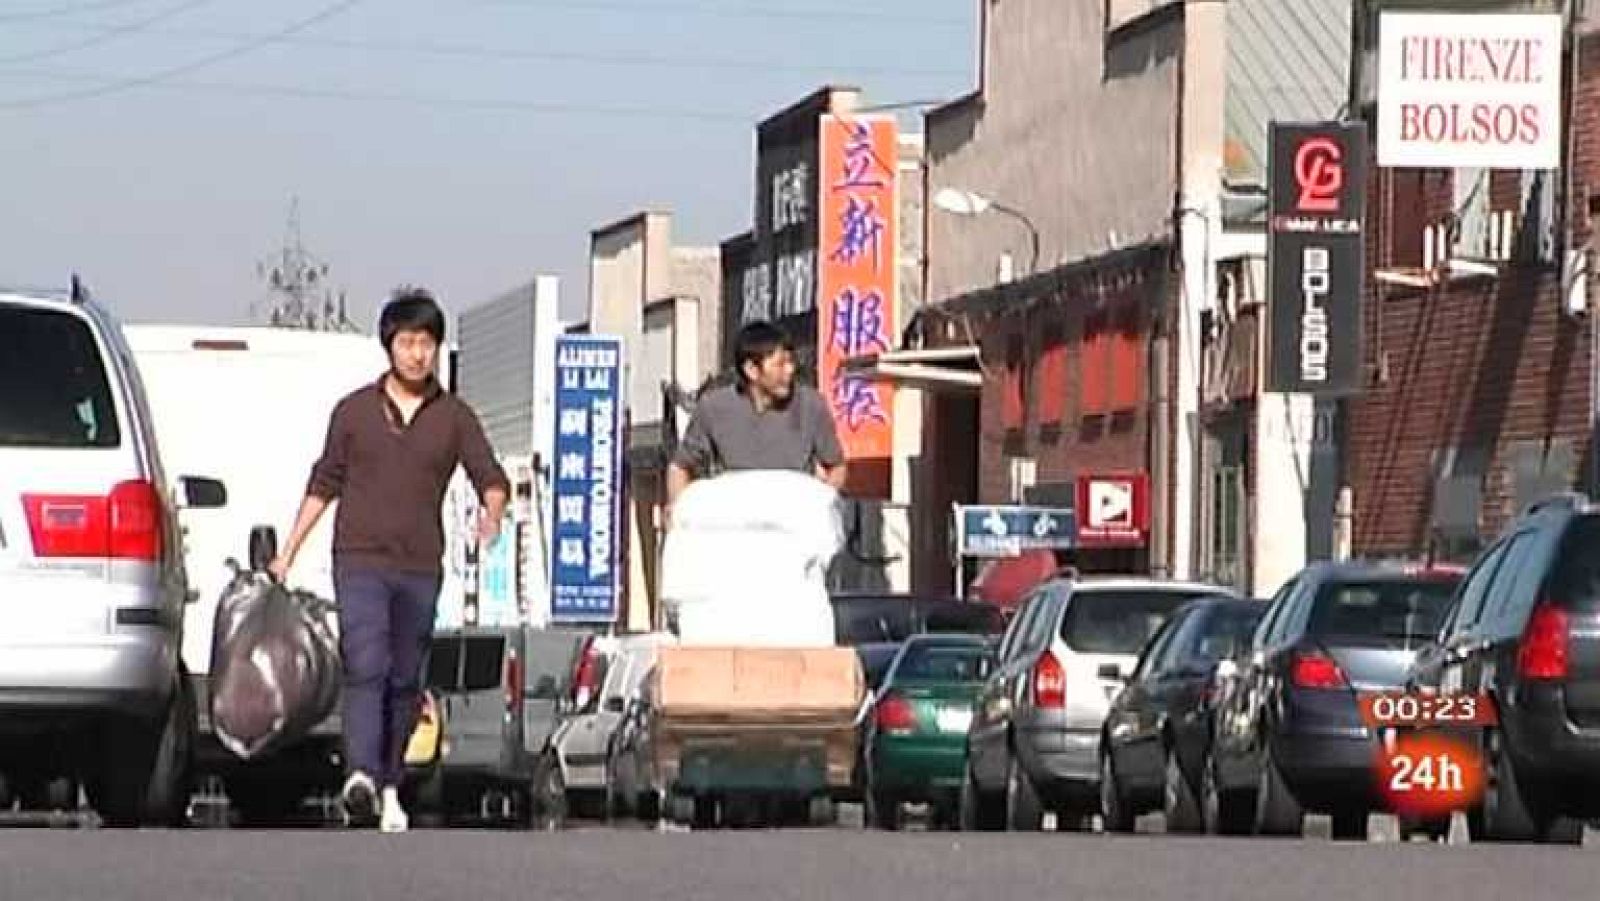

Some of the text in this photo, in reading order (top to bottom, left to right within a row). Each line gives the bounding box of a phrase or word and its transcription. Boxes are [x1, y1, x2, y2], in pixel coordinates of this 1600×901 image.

[1400, 36, 1543, 84] FIRENZE
[1400, 103, 1540, 145] BOLSOS
[1302, 248, 1329, 381] BOLSOS
